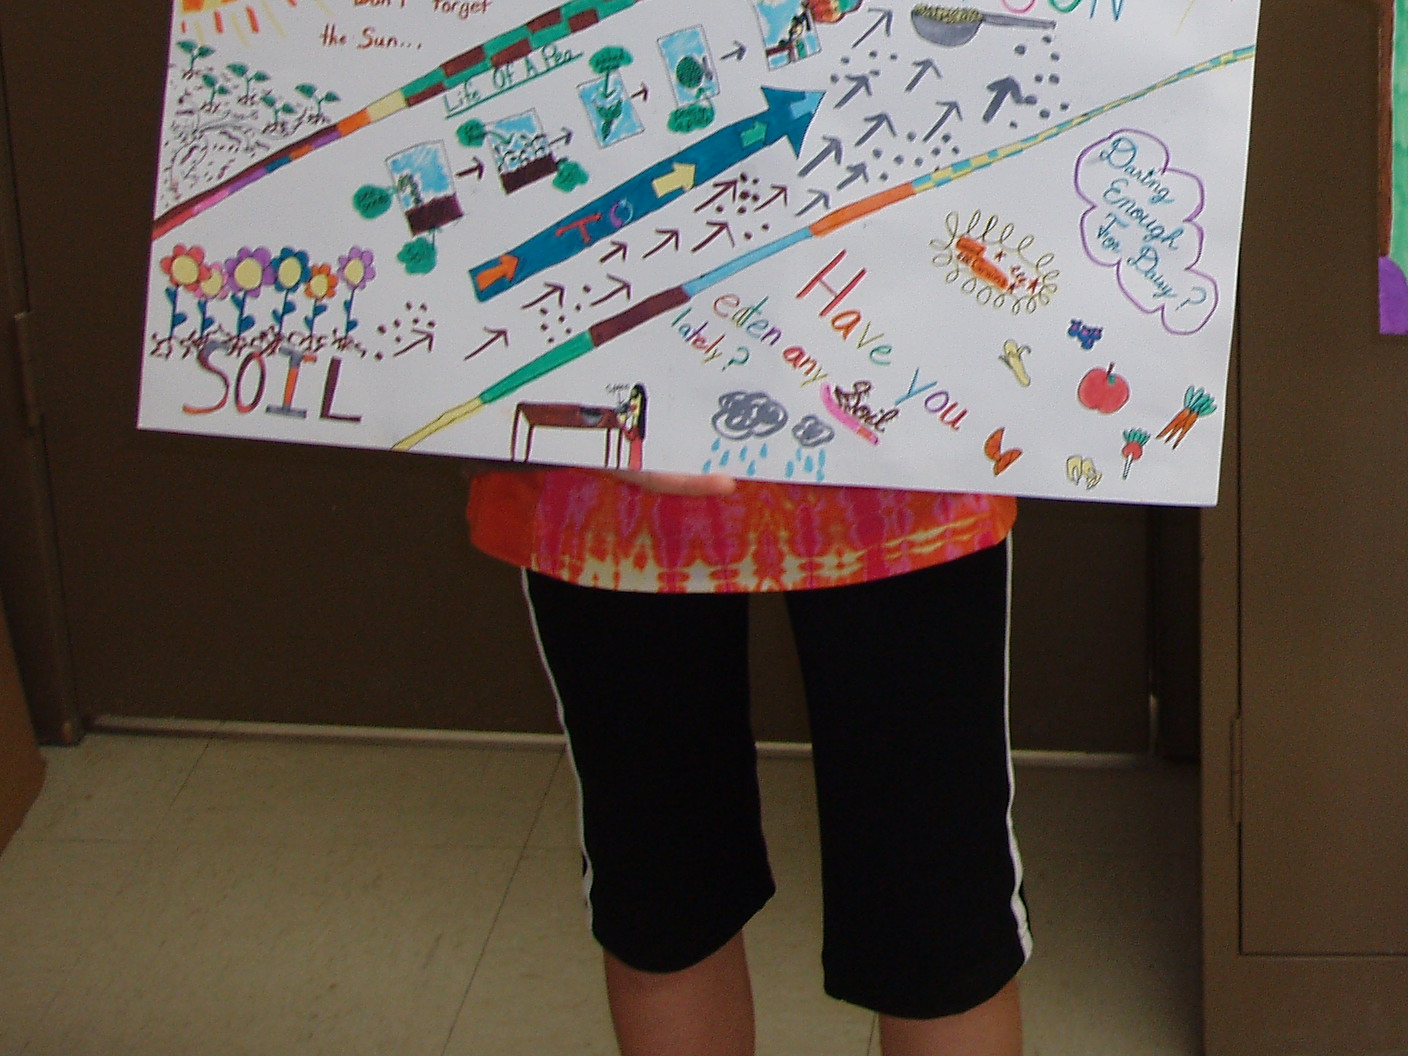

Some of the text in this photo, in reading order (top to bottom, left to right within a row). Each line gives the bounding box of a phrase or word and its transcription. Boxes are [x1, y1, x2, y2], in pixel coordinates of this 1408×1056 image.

[320, 24, 348, 47] the
[554, 197, 635, 244] TO
[1103, 178, 1186, 251] Enough
[795, 248, 893, 366] Have
[182, 341, 362, 422] SOIL
[782, 345, 829, 388] any
